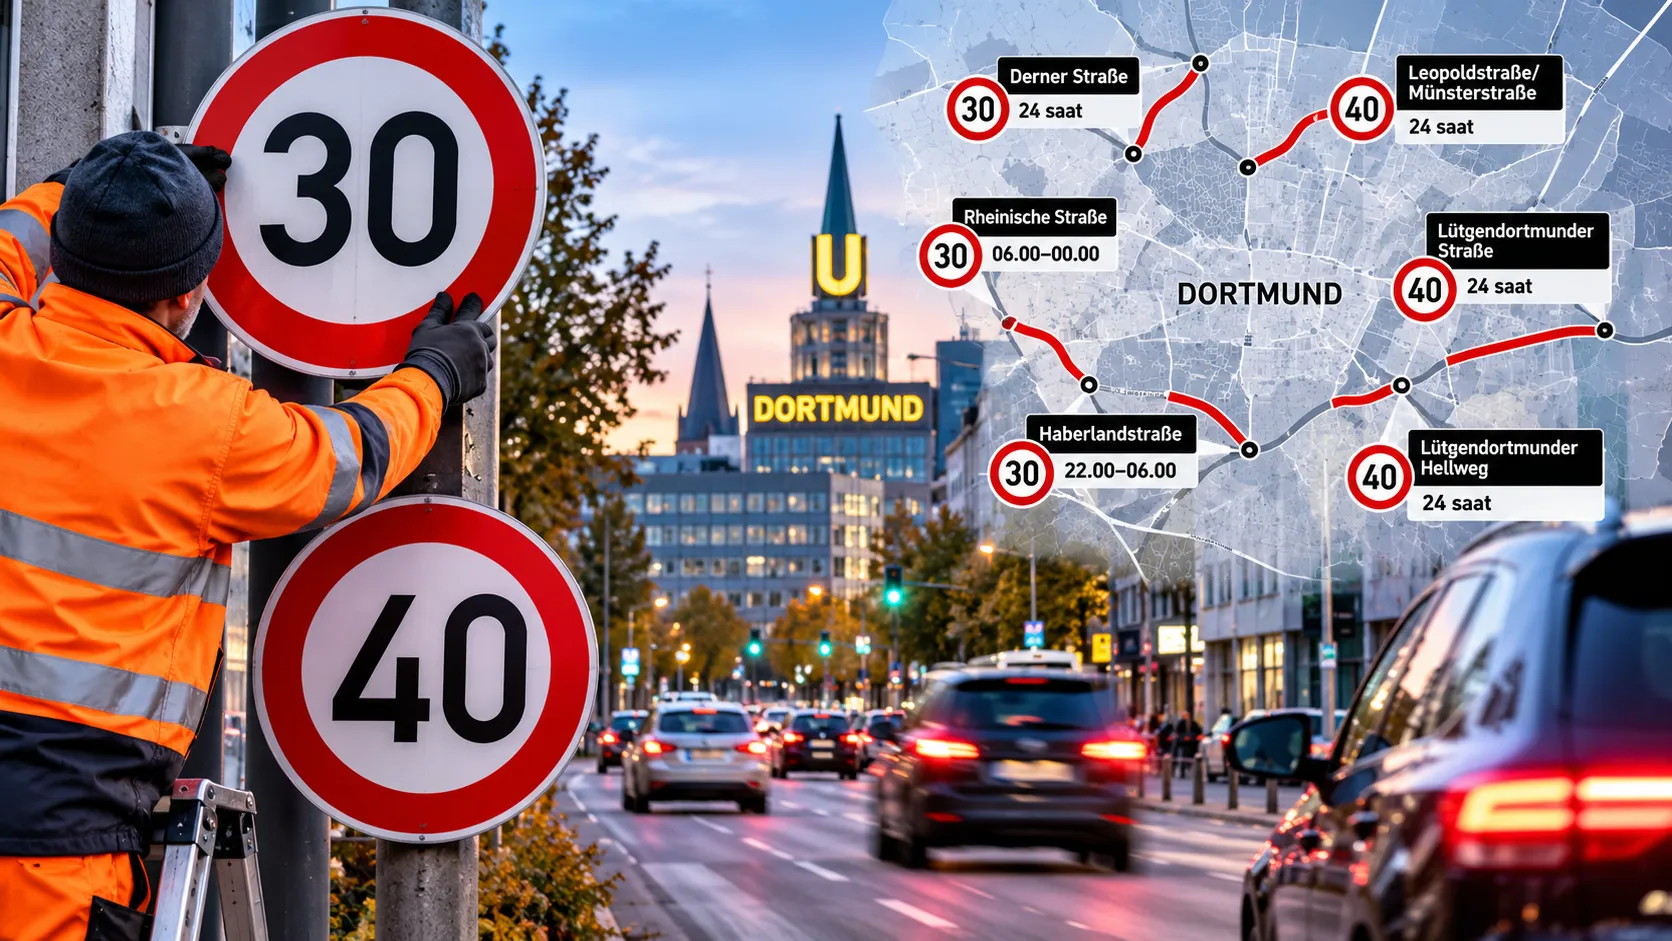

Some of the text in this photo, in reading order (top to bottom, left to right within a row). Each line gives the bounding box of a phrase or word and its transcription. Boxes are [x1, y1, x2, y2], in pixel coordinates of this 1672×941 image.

[259, 111, 459, 268] 30
[816, 233, 862, 297] U
[753, 394, 925, 423] DORTMUND
[332, 593, 528, 745] 40
